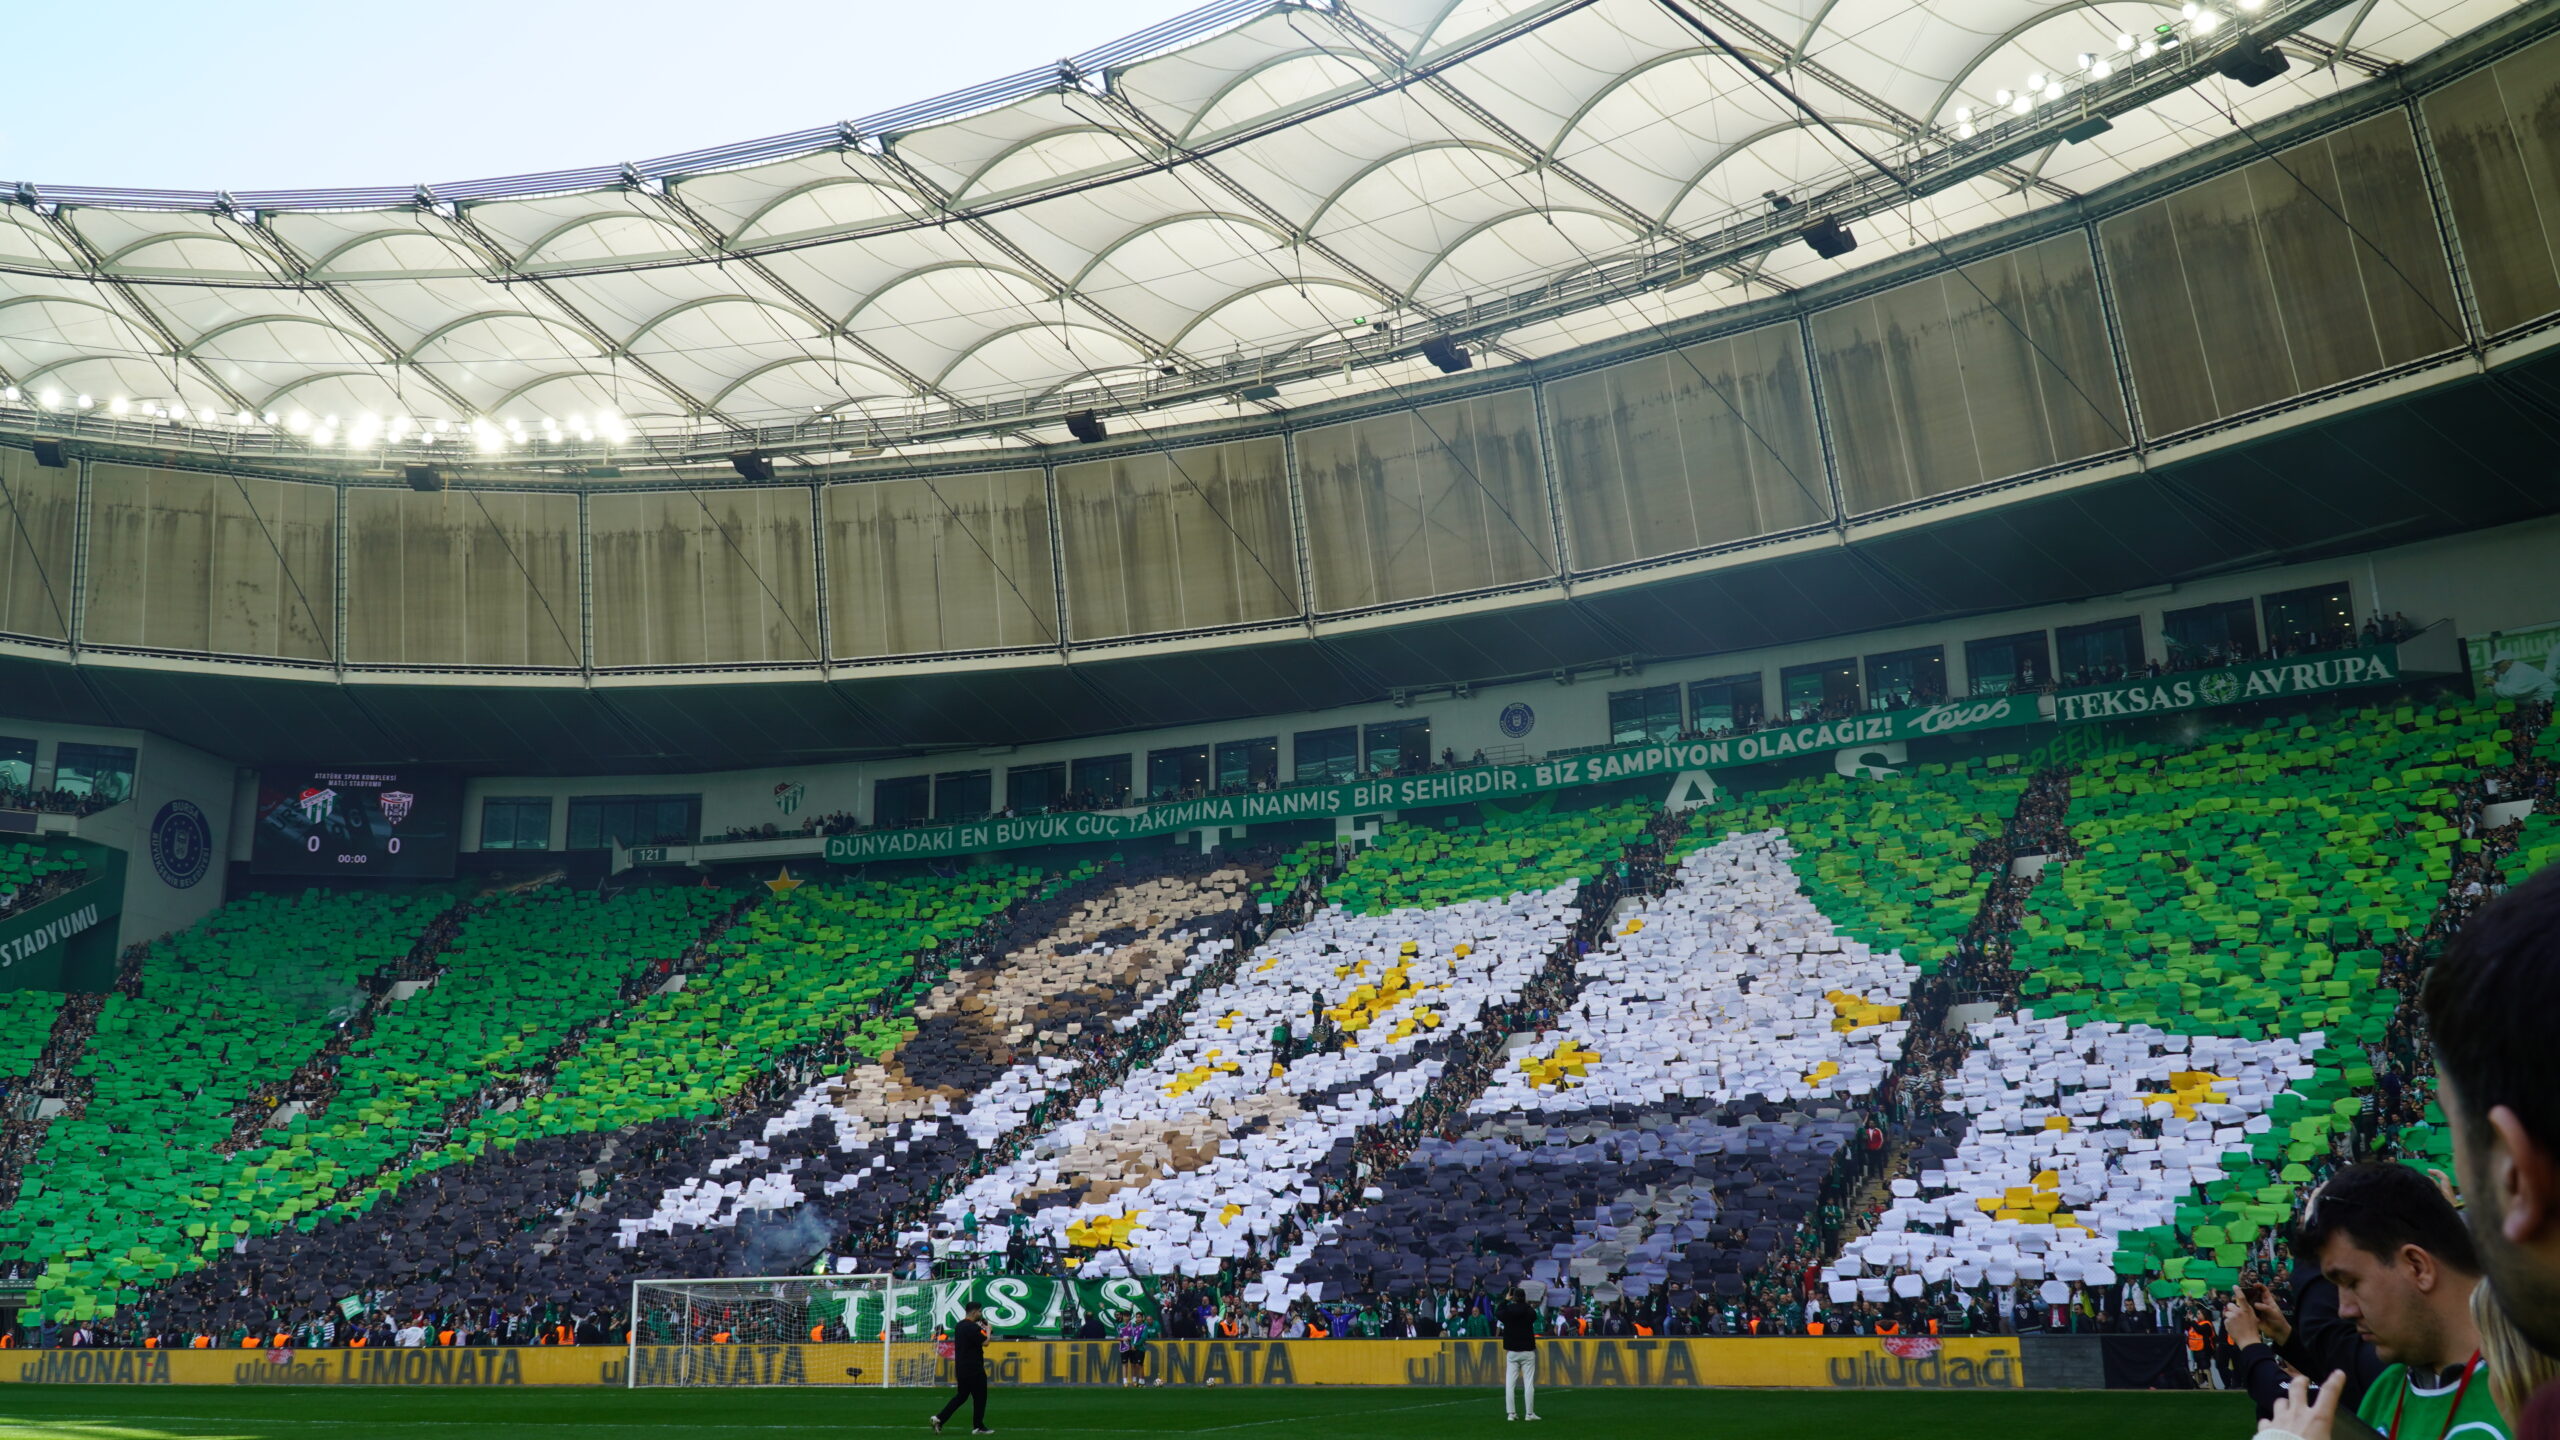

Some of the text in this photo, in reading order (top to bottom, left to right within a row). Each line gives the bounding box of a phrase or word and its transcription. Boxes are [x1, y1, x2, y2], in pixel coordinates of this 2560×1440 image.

[2057, 654, 2396, 721] TEKSAS AVRUPA
[832, 826, 953, 857] DÜNYADAKİ
[961, 828, 989, 848] EN
[996, 813, 1070, 844] BÜYÜK
[1128, 800, 1235, 832] TAKIMINA
[1242, 789, 1341, 818] İNANMIŞ
[1354, 780, 1394, 807] BİR
[1536, 761, 1580, 787] BİZ
[1586, 741, 1729, 783] ŞAMPİYON
[1738, 716, 1893, 761] OLACAĞIZ!
[307, 835, 320, 852] 0
[338, 854, 367, 863] 00:00
[388, 837, 400, 854] 0
[639, 849, 660, 861] 121
[0, 903, 99, 968] STADYUMU
[832, 1277, 1146, 1338] TEKSAS
